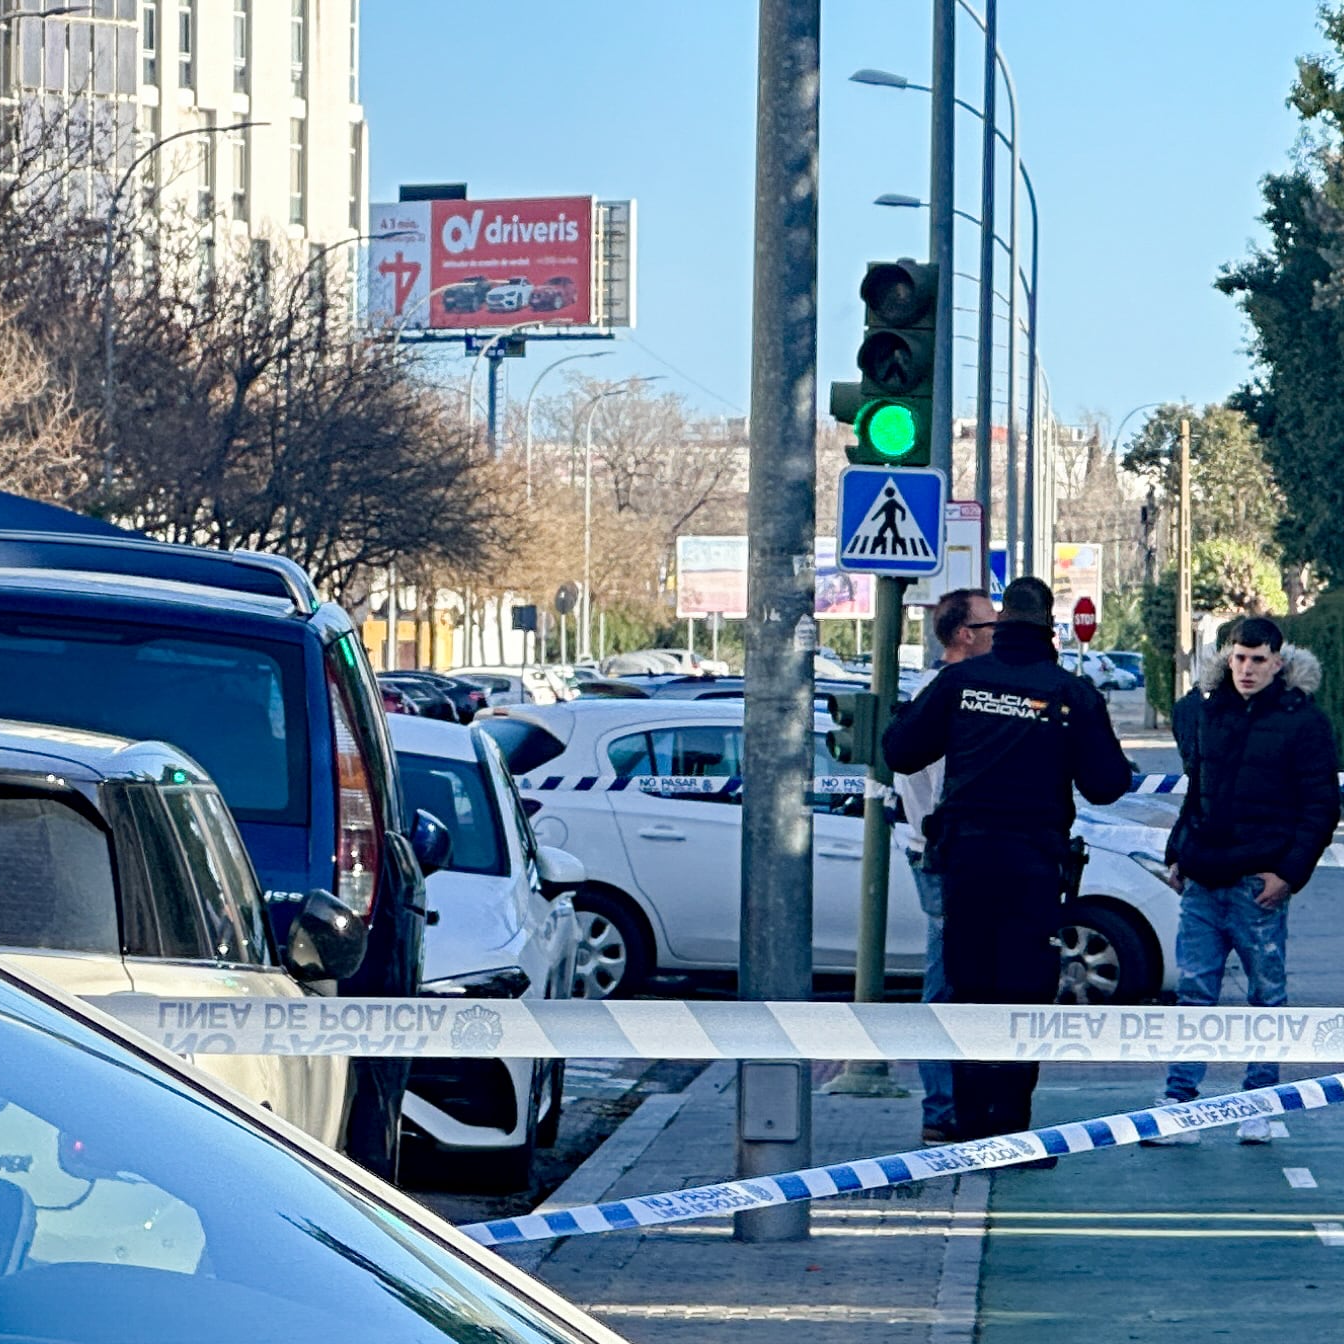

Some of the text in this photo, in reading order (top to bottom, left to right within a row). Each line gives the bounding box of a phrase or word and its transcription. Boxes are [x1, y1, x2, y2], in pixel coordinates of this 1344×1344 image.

[484, 213, 579, 244] driveris
[1075, 614, 1095, 625] STOP
[822, 778, 839, 787] NO
